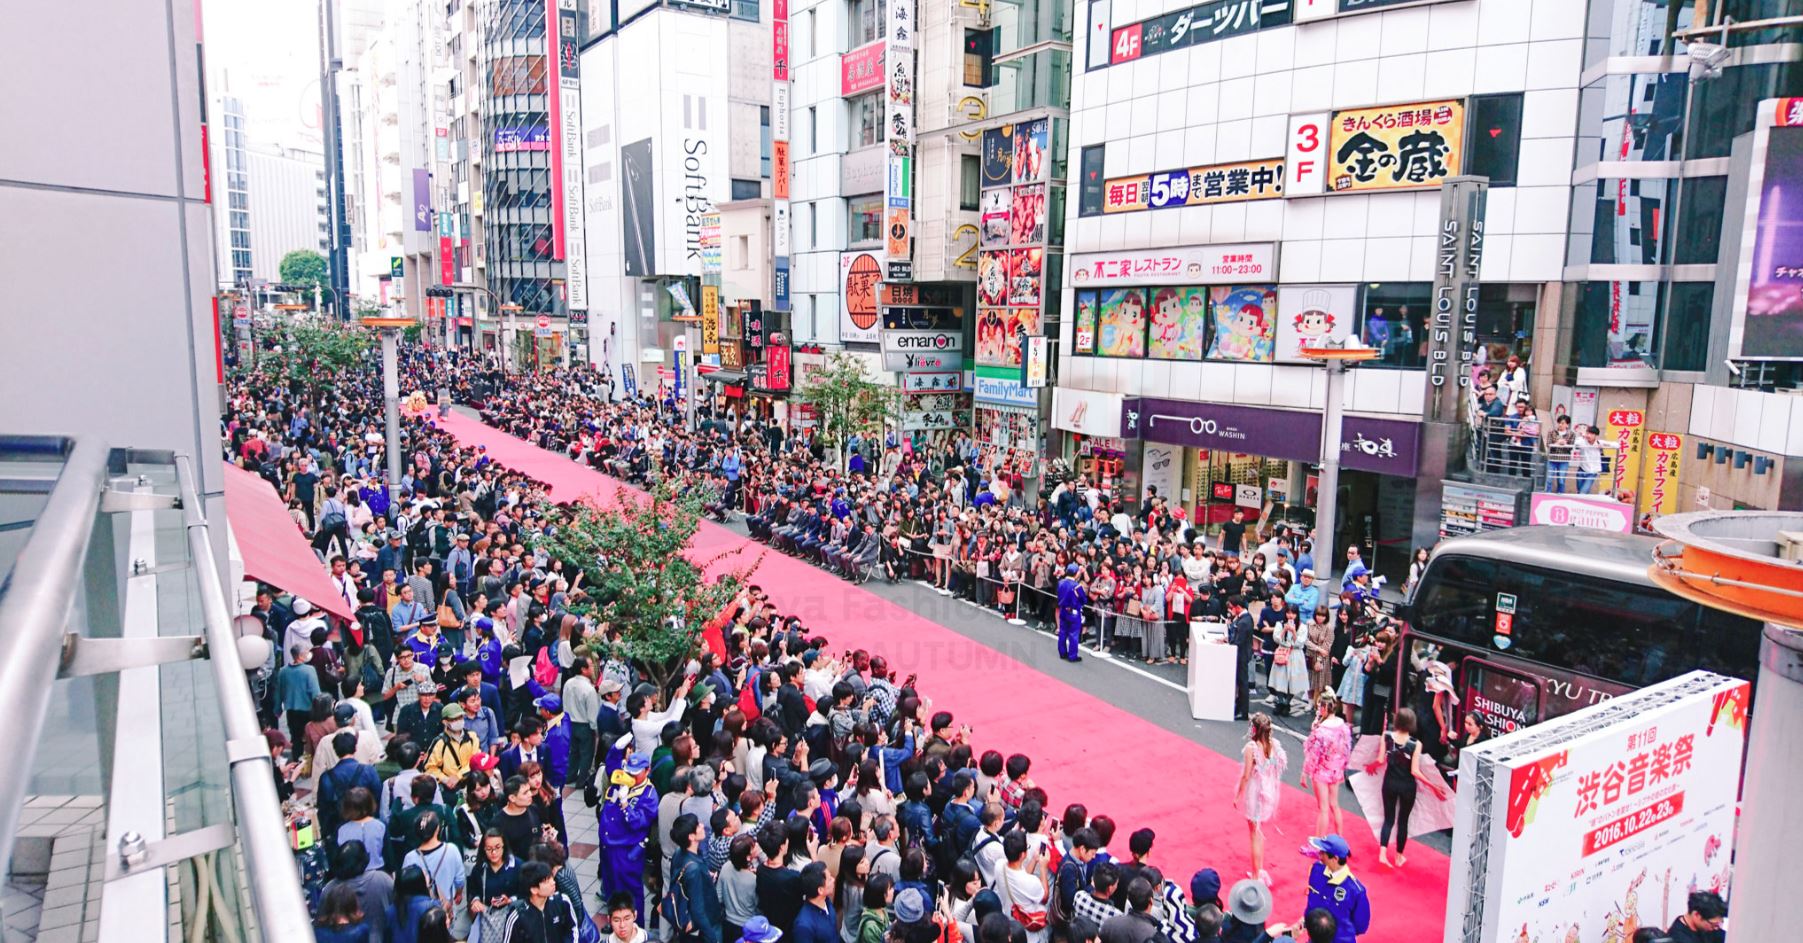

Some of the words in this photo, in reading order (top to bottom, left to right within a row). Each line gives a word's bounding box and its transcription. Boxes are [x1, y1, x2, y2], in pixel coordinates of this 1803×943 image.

[1171, 0, 1288, 44] ダーツバー
[1115, 34, 1138, 57] 4F
[565, 111, 576, 159] SoftBank
[1342, 109, 1432, 132] きんくら酒場
[1337, 129, 1449, 182] 金の蔵
[568, 184, 579, 233] SoftBank
[683, 138, 708, 261] SoftBank
[843, 256, 850, 267] 2F
[953, 224, 979, 267] 2
[1222, 254, 1252, 263] 営業時間
[1440, 220, 1458, 278] SAINT
[1467, 221, 1483, 279] SAINT
[569, 257, 581, 305] SoftBank
[1093, 259, 1131, 279] 不二家
[1134, 257, 1183, 273] レストラン
[1211, 264, 1262, 275] 11:00-23:00
[1434, 287, 1453, 343] LOUIS
[1463, 287, 1479, 343] LOUIS
[1078, 333, 1091, 346] 2F
[1432, 350, 1446, 386] BLD
[1459, 351, 1472, 387] BLD
[978, 380, 1033, 399] FamilyMart
[1219, 430, 1246, 440] WASHIN
[1612, 412, 1640, 426] 大粒
[1087, 436, 1110, 448] SALE
[1615, 427, 1631, 489] カキフライ
[1631, 428, 1641, 453] 広島産
[1651, 435, 1678, 449] 大粒
[1652, 451, 1670, 513] カキフライ
[1669, 452, 1679, 478] 広島産
[1474, 696, 1527, 722] SHIBUYA
[1627, 726, 1657, 751] 第11回
[1574, 733, 1695, 819] 渋谷音楽祭
